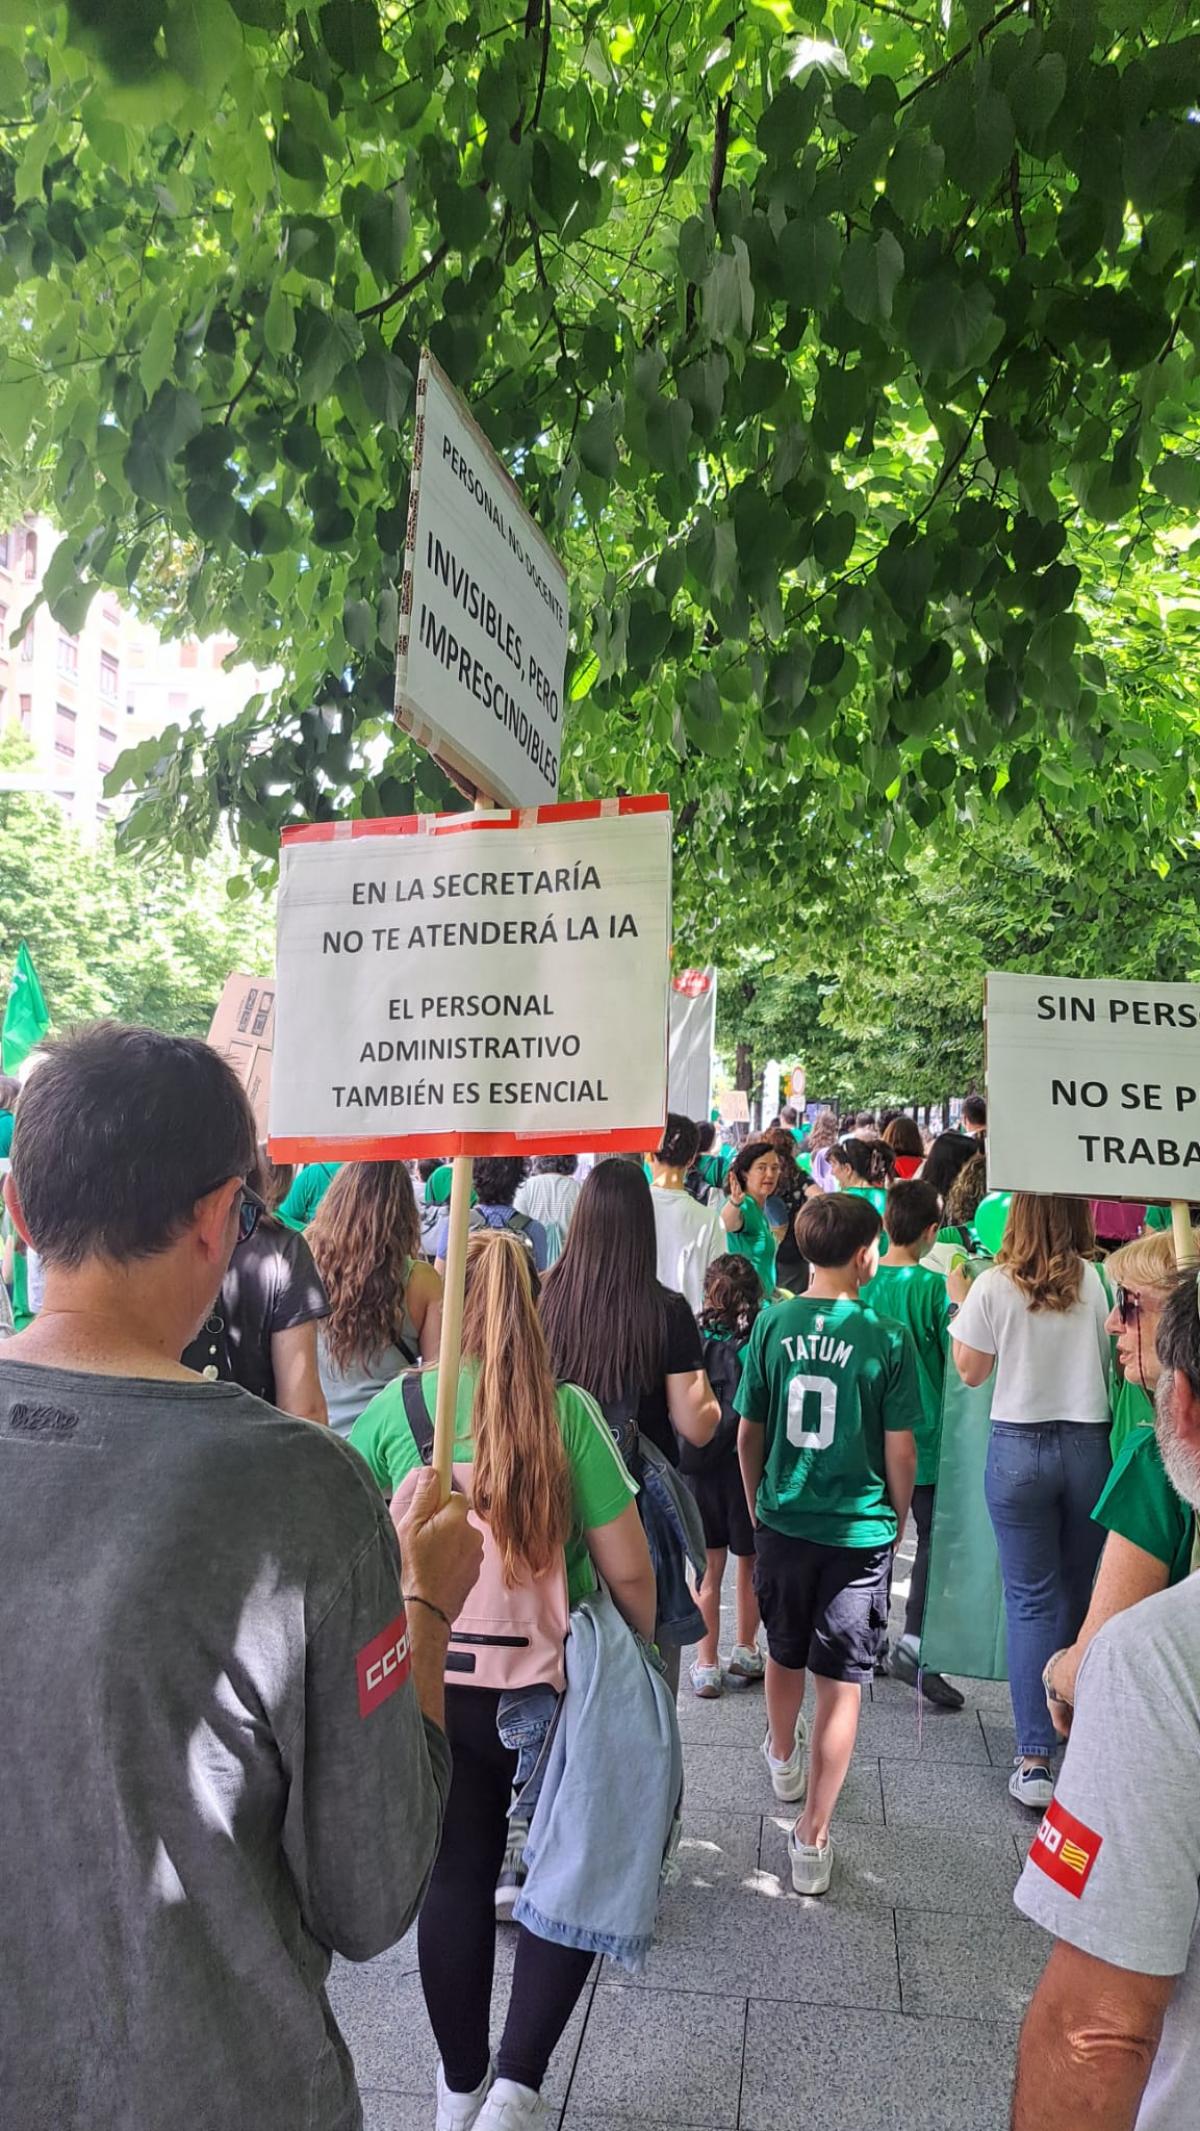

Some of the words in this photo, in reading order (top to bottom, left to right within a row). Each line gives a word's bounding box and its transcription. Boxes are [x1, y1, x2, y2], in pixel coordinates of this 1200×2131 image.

[442, 434, 506, 540] PERSONAL
[508, 525, 525, 564] NO
[525, 551, 564, 629] DOCENTE
[427, 531, 525, 682] INVISIBLES,
[529, 654, 558, 723] PERO
[419, 603, 557, 788] IMPRESCINDIBLES
[352, 881, 386, 905] EN
[396, 879, 424, 902] LA
[432, 860, 601, 899] SECRETARÍA
[323, 930, 363, 954] NO
[372, 927, 399, 951] TE
[408, 913, 558, 949] ATENDERÁ
[567, 915, 599, 941] LA
[609, 913, 639, 939] IA
[389, 998, 413, 1021] EL
[421, 994, 554, 1018] PERSONAL
[1037, 994, 1095, 1022] SIN
[1109, 999, 1200, 1028] PERS
[359, 1034, 581, 1063] ADMINISTRATIVO
[332, 1078, 444, 1108] TAMBIÉN
[453, 1082, 481, 1104] ES
[489, 1079, 608, 1105] ESENCIAL
[1052, 1079, 1108, 1108] NO
[1121, 1083, 1163, 1111] SE
[780, 1334, 854, 1369] TATUM
[366, 1633, 410, 1691] CCO
